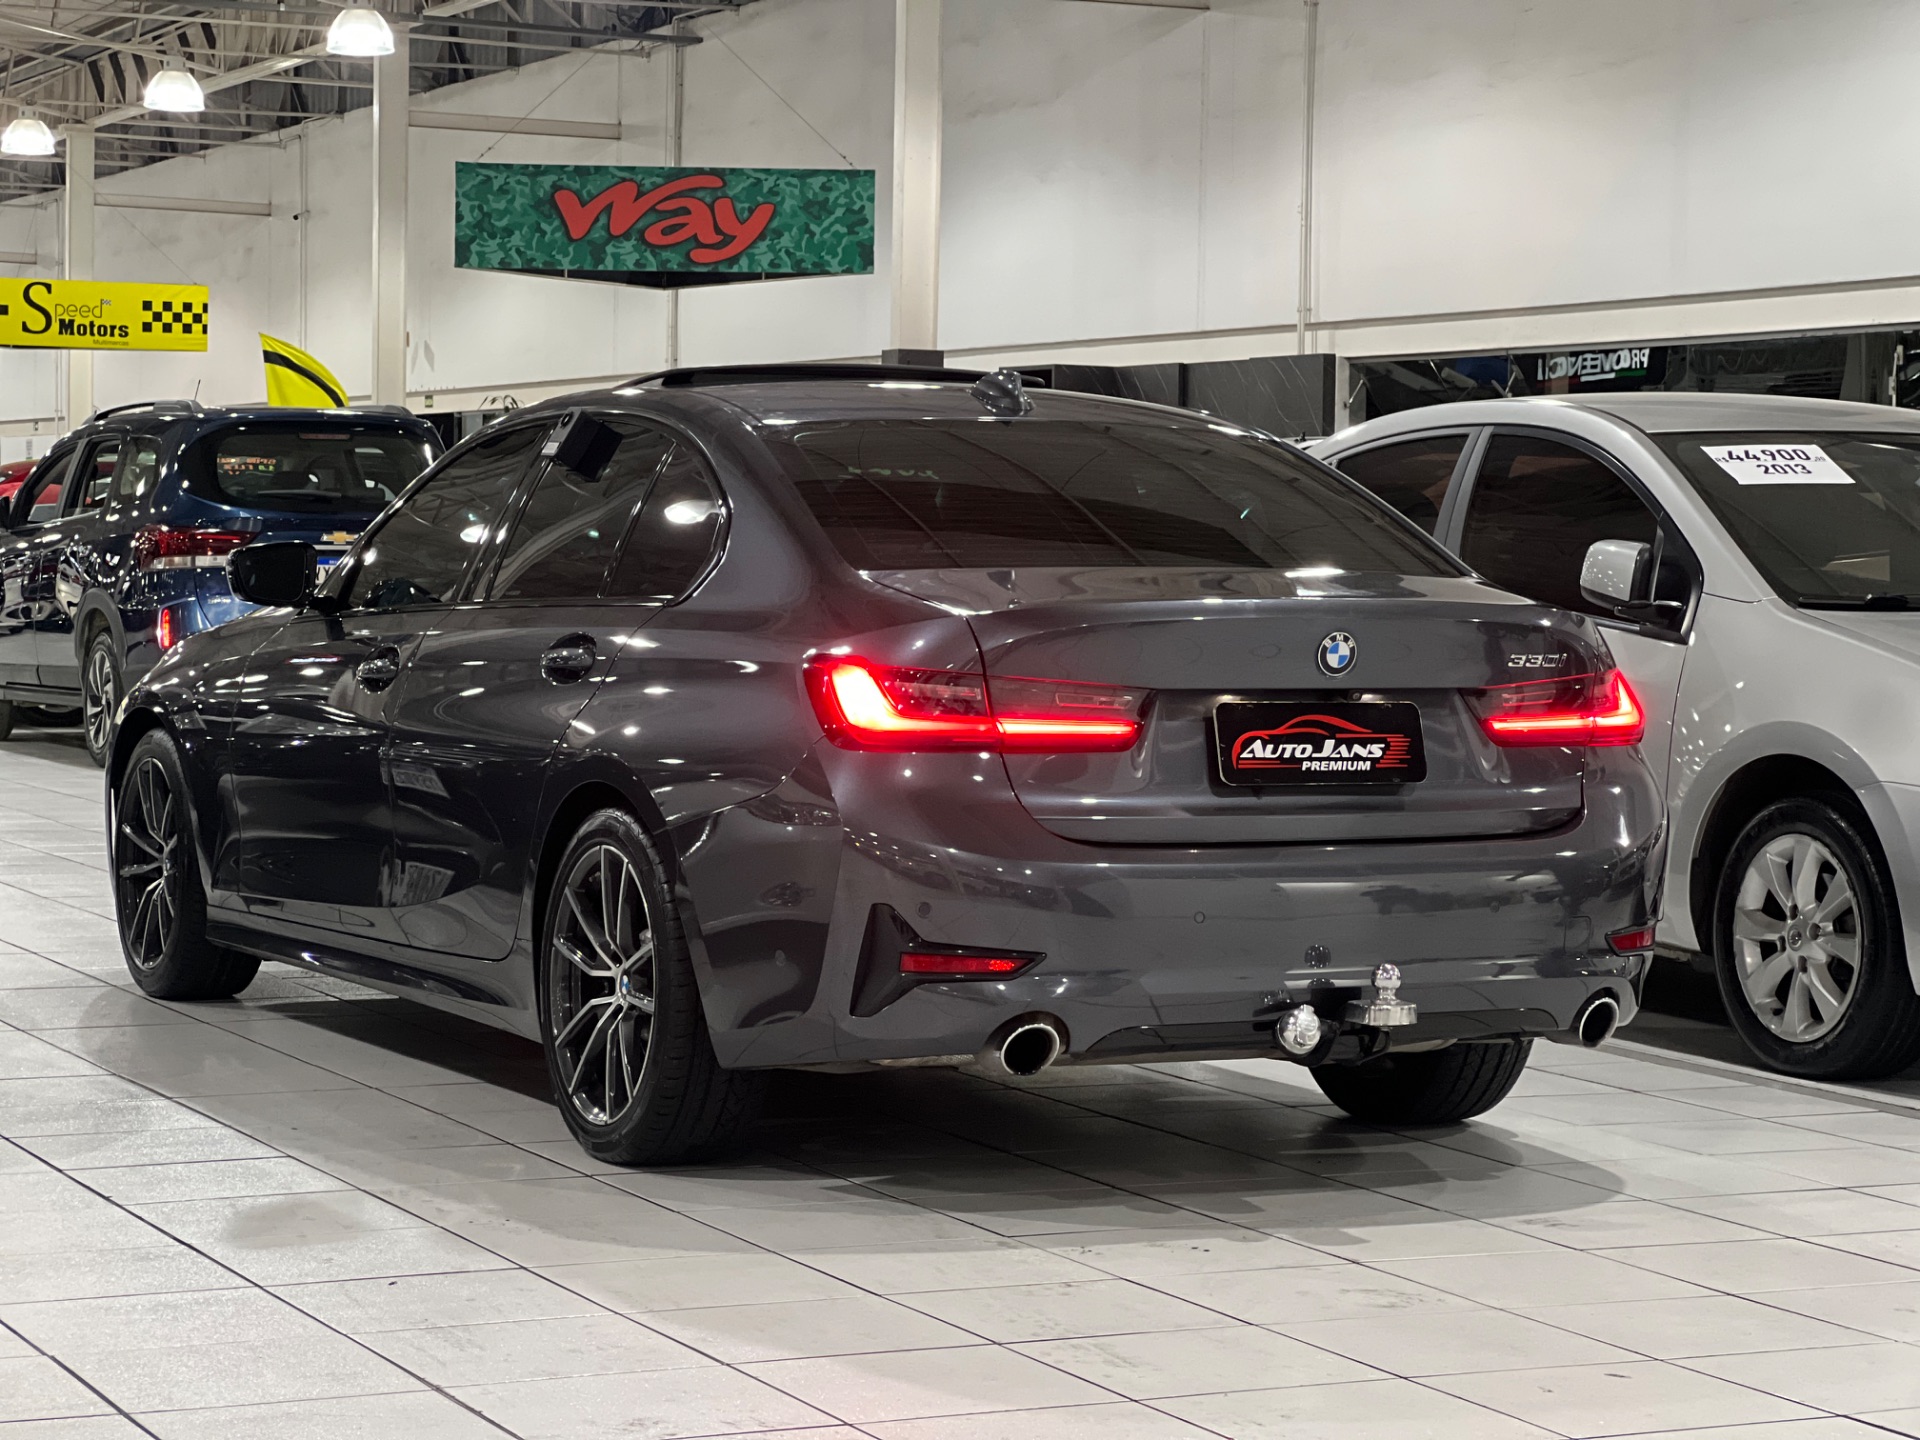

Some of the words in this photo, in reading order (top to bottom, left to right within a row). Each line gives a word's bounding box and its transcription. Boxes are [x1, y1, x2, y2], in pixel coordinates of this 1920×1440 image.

[553, 174, 776, 264] Way
[21, 281, 103, 335] Speed
[58, 317, 130, 338] Motors
[1756, 463, 1813, 475] 2013
[1507, 653, 1567, 668] 330i
[1301, 760, 1371, 772] PREMIUM
